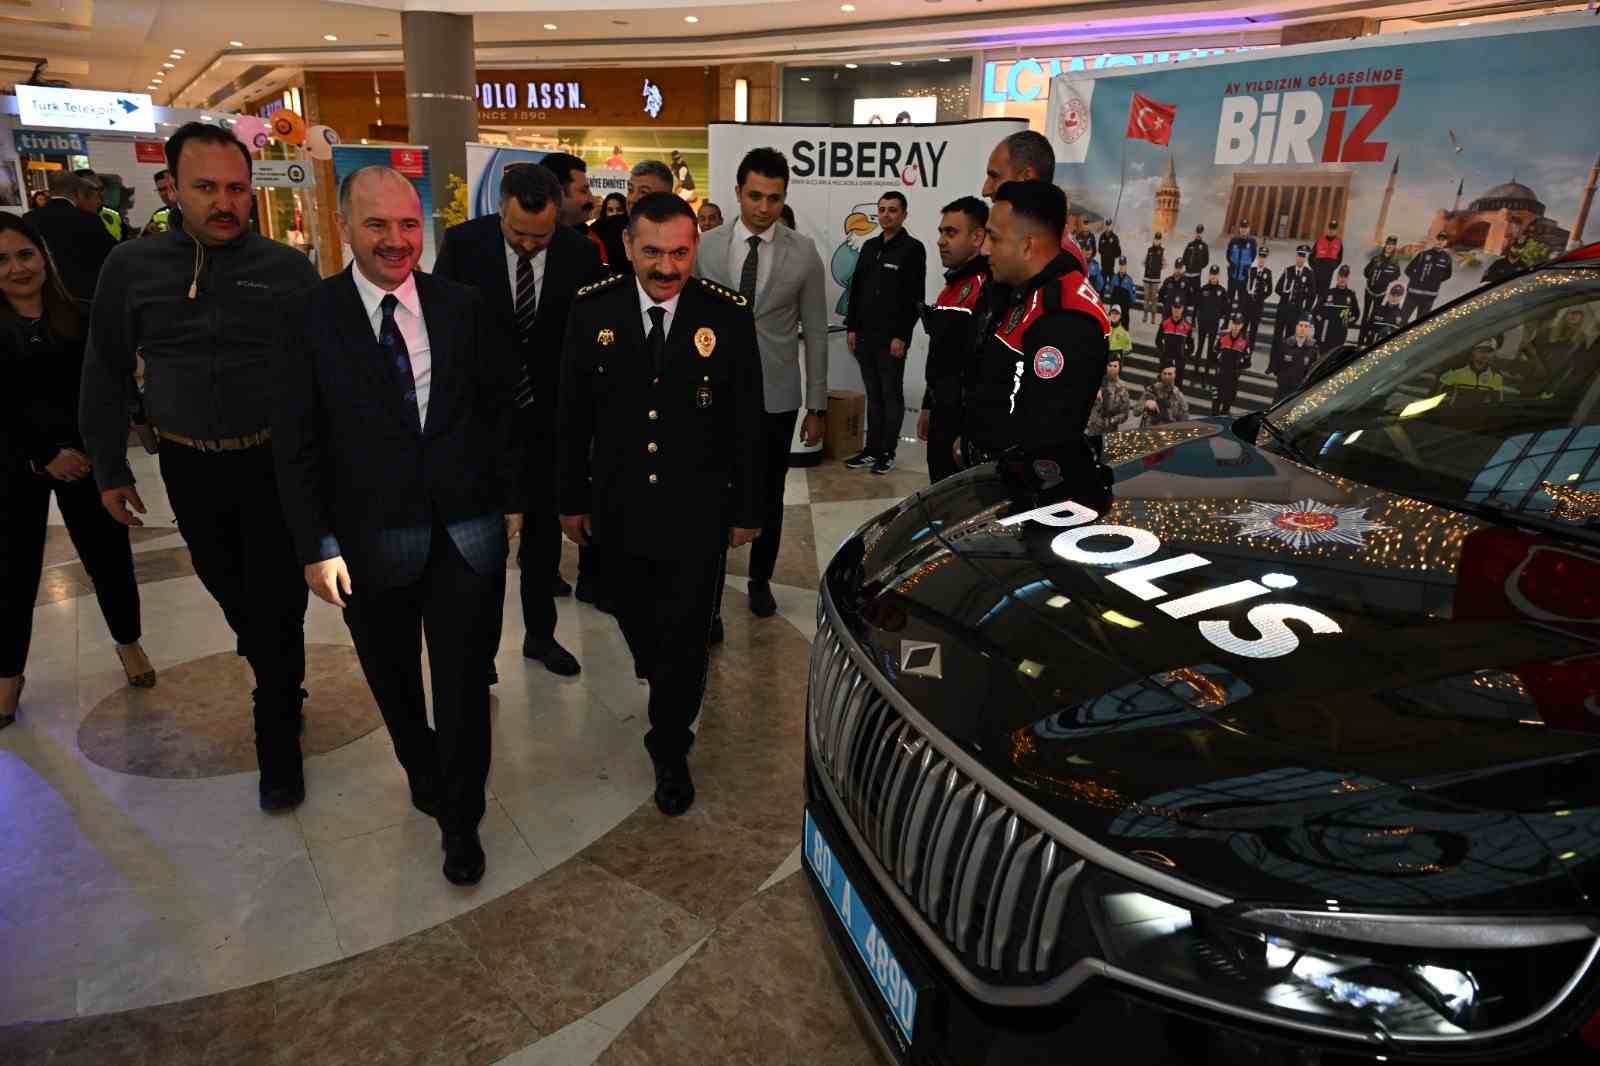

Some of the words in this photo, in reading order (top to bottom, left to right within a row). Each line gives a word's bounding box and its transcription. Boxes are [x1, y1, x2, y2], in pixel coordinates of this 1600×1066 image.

[527, 82, 586, 109] ASSN.
[984, 59, 1042, 101] LC
[1225, 82, 1241, 95] AY
[1246, 76, 1302, 93] YILDIZIN
[1308, 67, 1405, 88] GÖLGESİNDE
[841, 879, 851, 928] A
